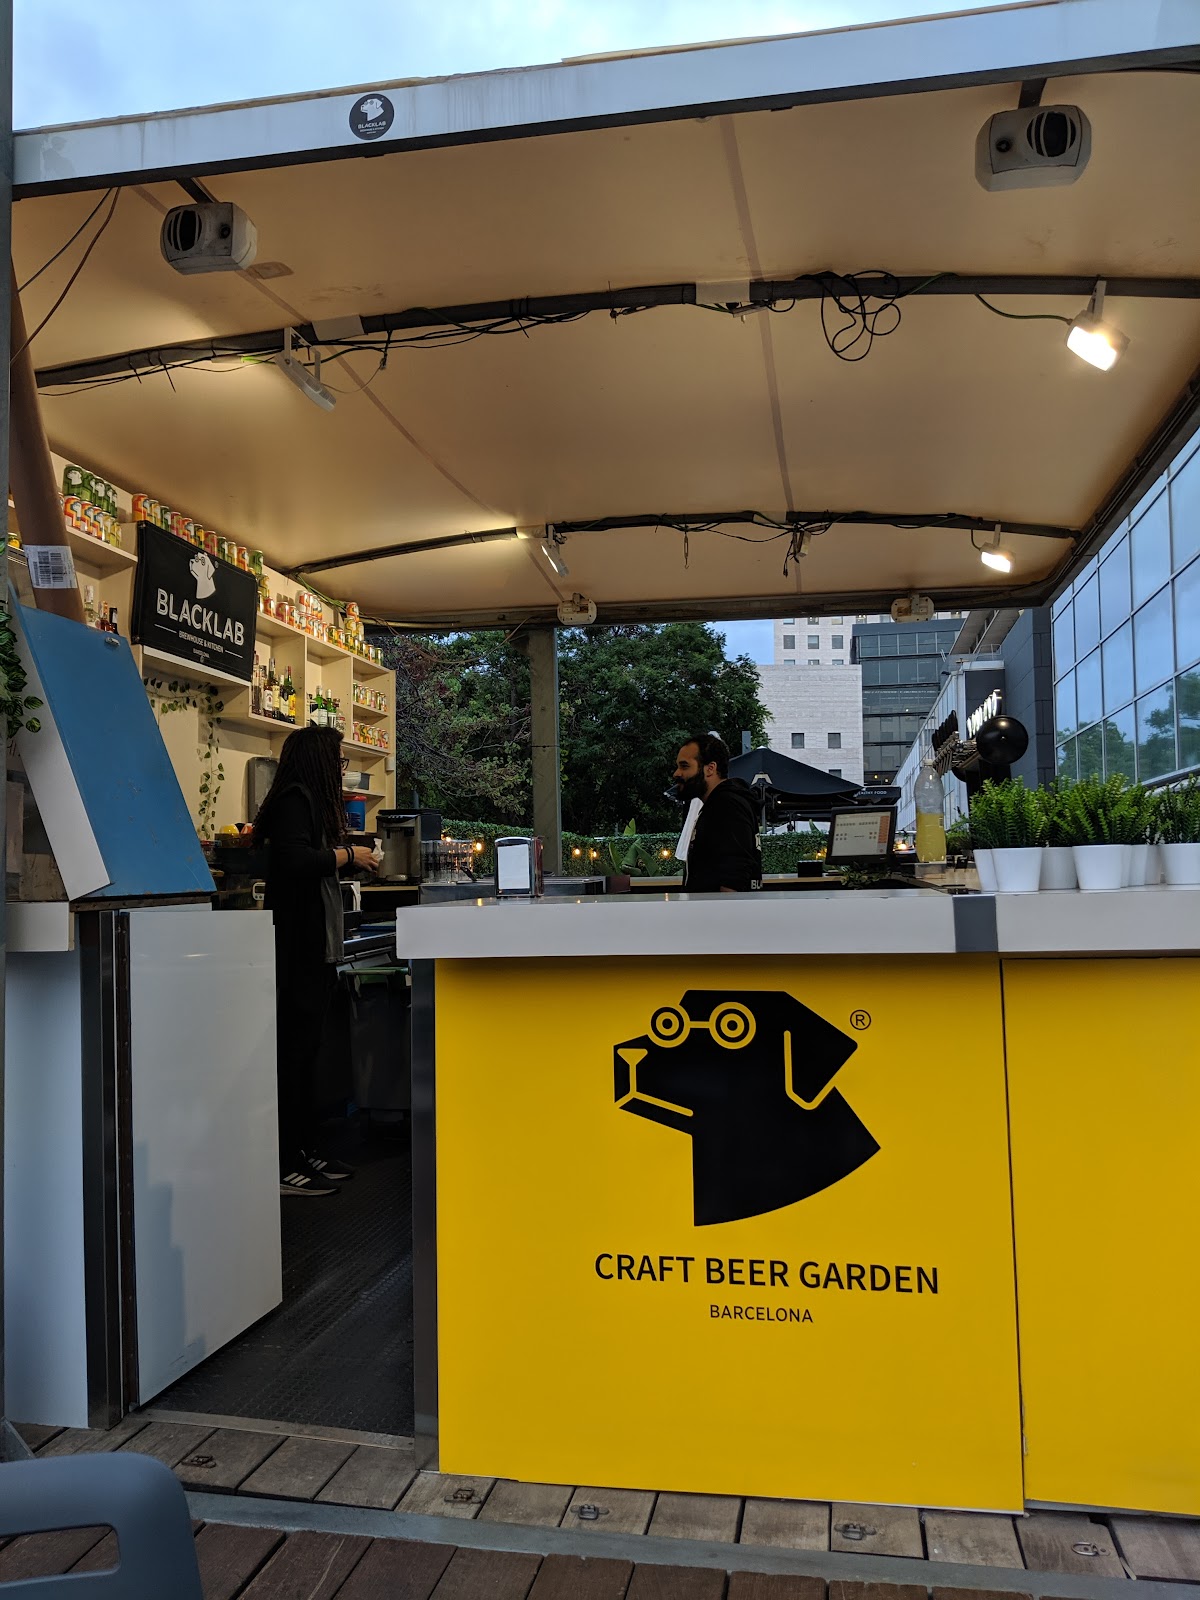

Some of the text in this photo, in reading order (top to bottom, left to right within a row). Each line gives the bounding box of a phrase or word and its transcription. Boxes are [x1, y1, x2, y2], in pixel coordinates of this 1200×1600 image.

[358, 121, 387, 129] BLACKLAB
[157, 588, 245, 646] BLACKLAB
[595, 1253, 939, 1295] CRAFT BEER GARDEN
[710, 1304, 814, 1324] BARCELONA
